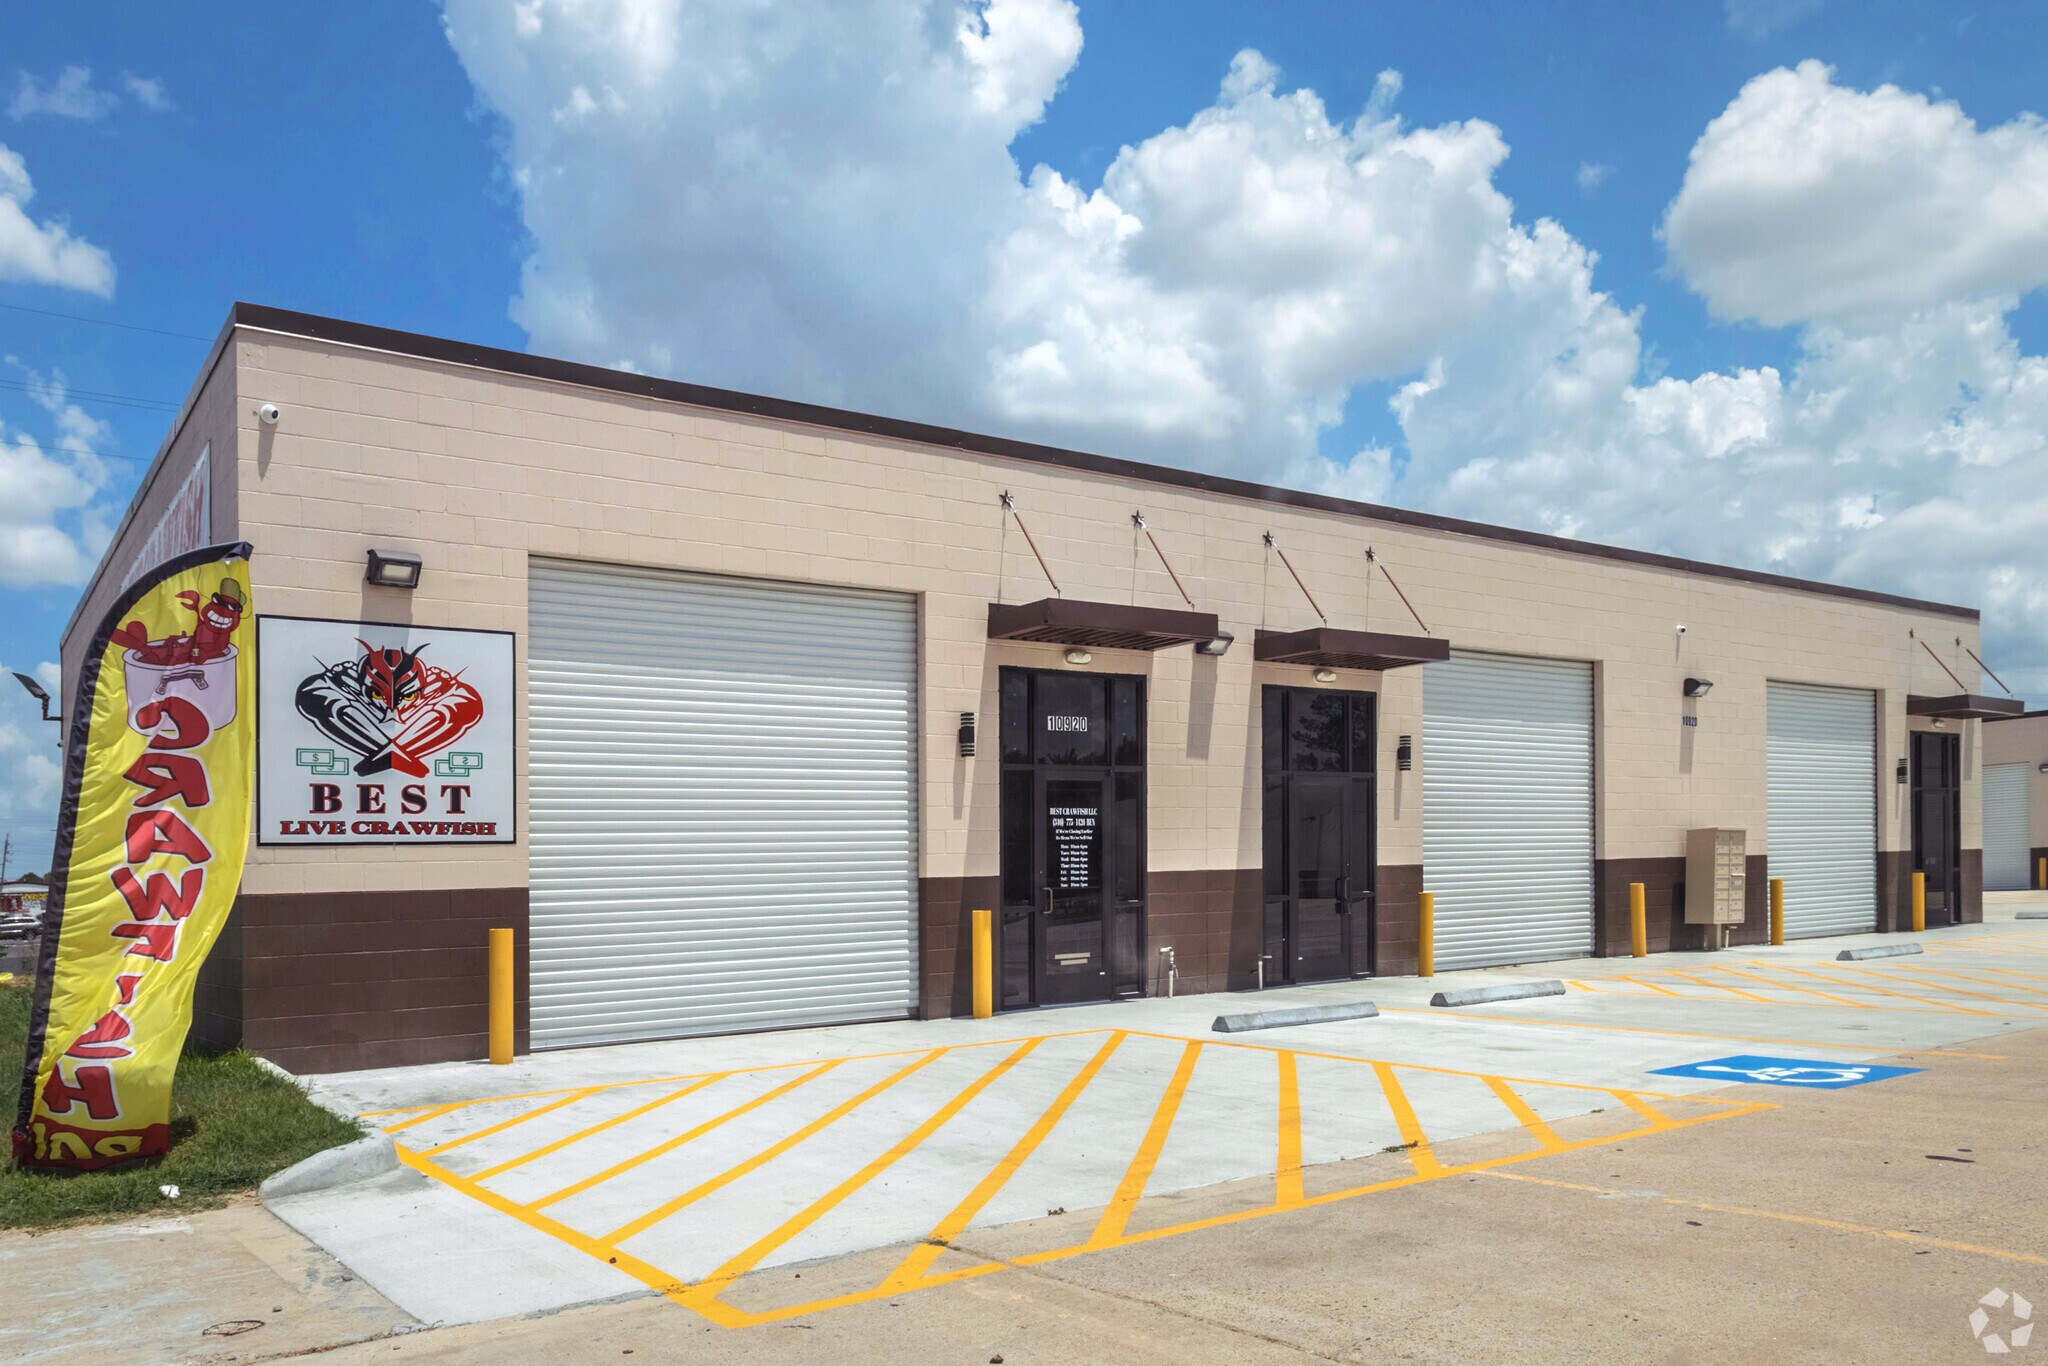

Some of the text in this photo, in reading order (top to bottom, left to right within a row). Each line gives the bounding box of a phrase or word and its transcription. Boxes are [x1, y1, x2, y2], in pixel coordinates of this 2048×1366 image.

[1047, 715, 1088, 732] 10920
[1682, 715, 1698, 727] 10920
[309, 783, 471, 814] BEST
[280, 820, 497, 836] LIVE CRAWFISH
